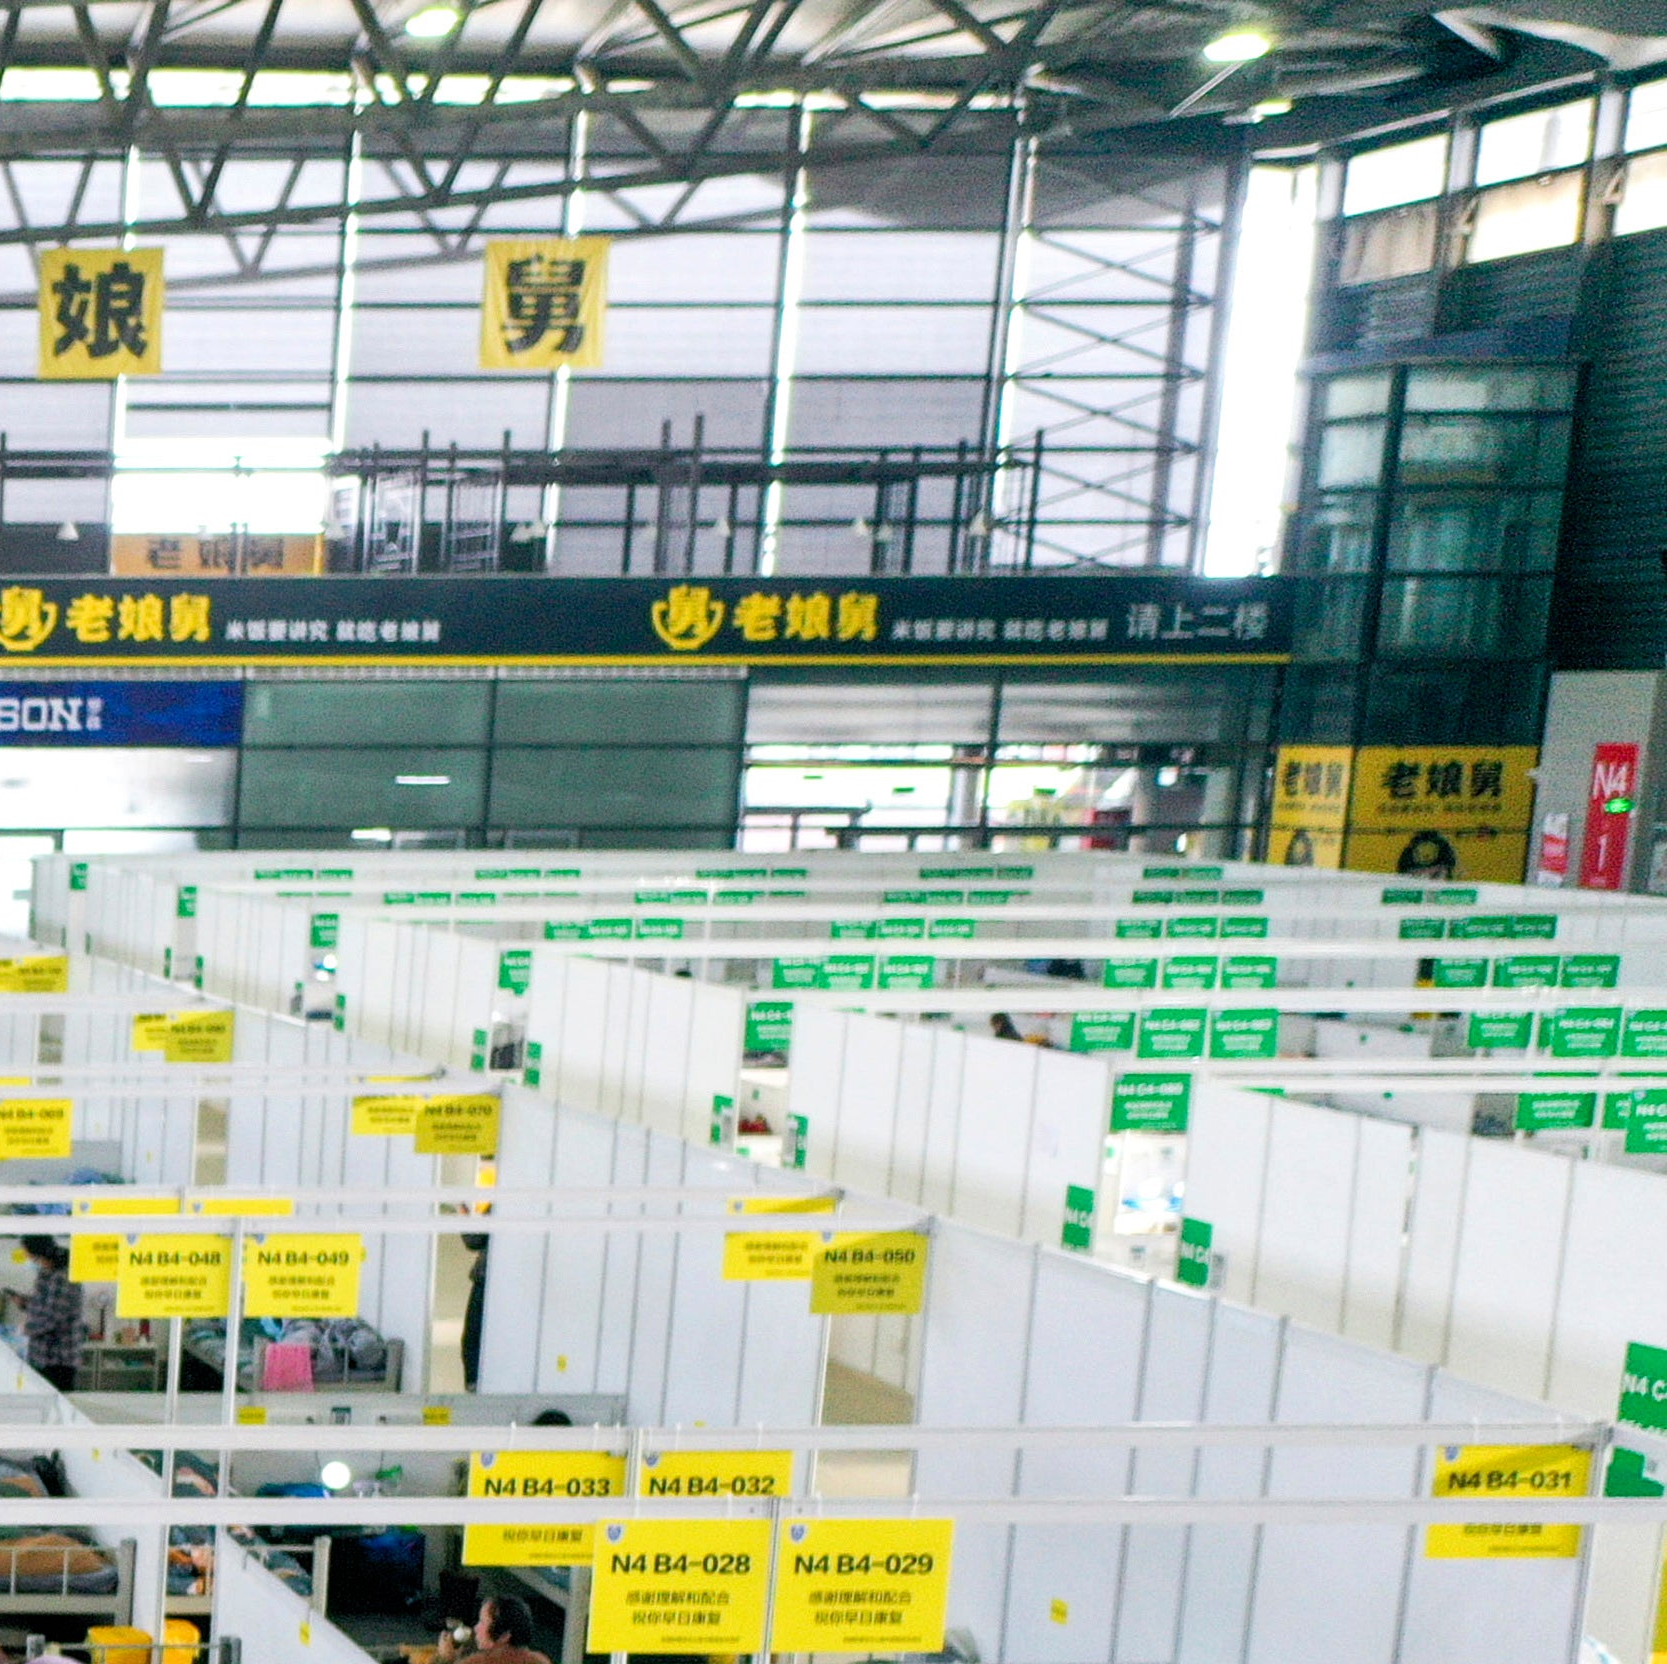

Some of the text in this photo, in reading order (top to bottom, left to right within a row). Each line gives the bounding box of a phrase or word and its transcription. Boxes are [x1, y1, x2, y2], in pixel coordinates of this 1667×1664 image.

[53, 264, 149, 361] 娘
[500, 258, 584, 356] 舅
[66, 592, 211, 643] 老娘舅
[733, 592, 879, 642] 老娘舅
[1127, 602, 1266, 641] 请上二楼
[1281, 761, 1343, 796] 老娘舅
[1383, 761, 1503, 798] 老娘舅
[1593, 763, 1627, 797] N4
[1597, 836, 1607, 872] 1
[1624, 1376, 1648, 1395] N4
[485, 1478, 610, 1496] N4 B4-033
[649, 1477, 774, 1496] N4 B4-032
[1448, 1470, 1571, 1489] N4 B4-031
[612, 1554, 750, 1574] N4 B4-028
[795, 1554, 933, 1574] N4 B4-029
